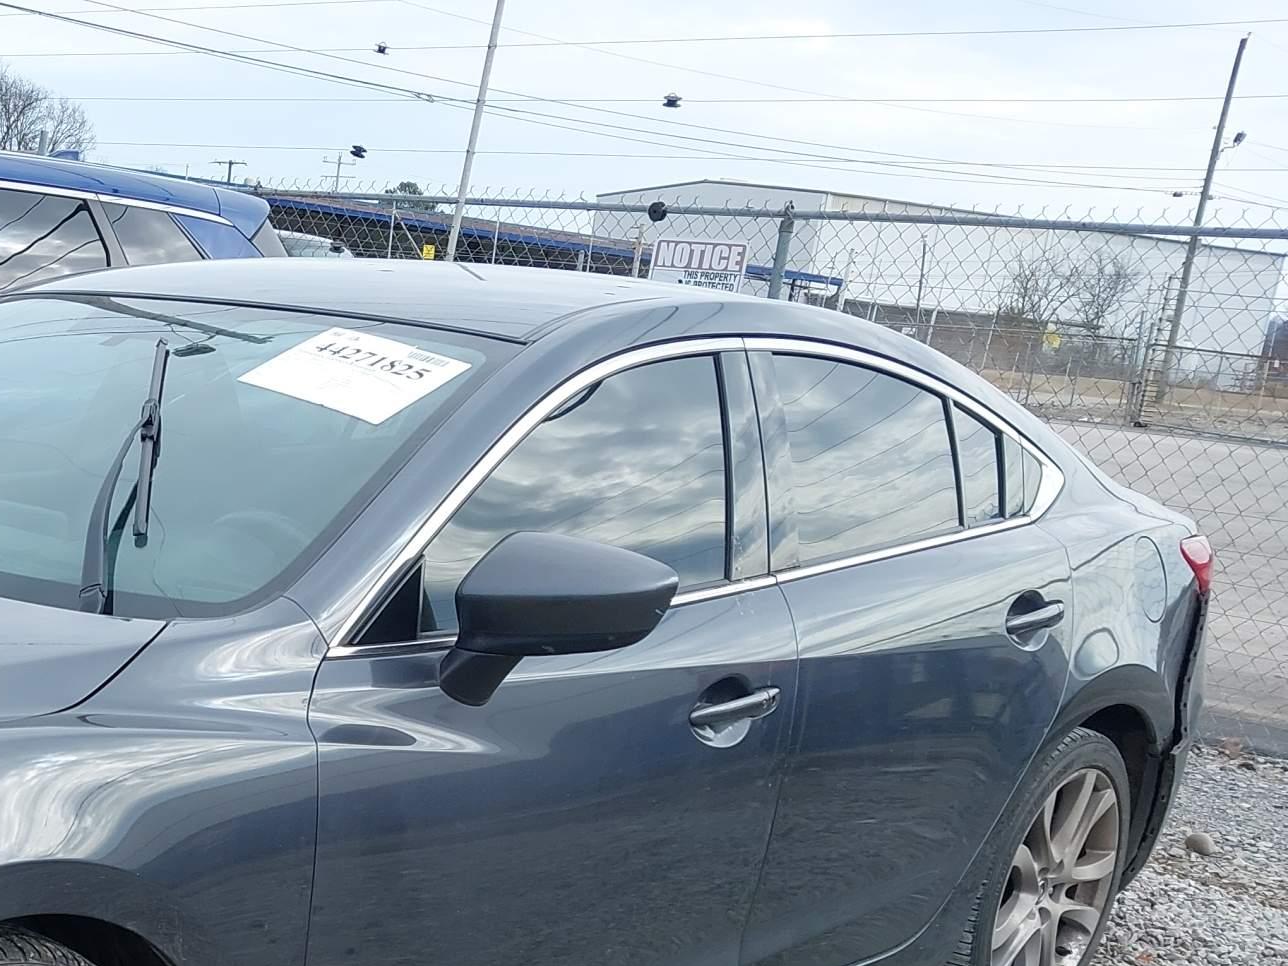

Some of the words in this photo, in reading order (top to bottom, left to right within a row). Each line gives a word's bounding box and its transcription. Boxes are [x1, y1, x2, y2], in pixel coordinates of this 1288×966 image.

[657, 241, 743, 271] NOTICE
[683, 270, 699, 280] THIS
[699, 271, 738, 283] PROPERTY
[315, 342, 432, 381] 44271825
